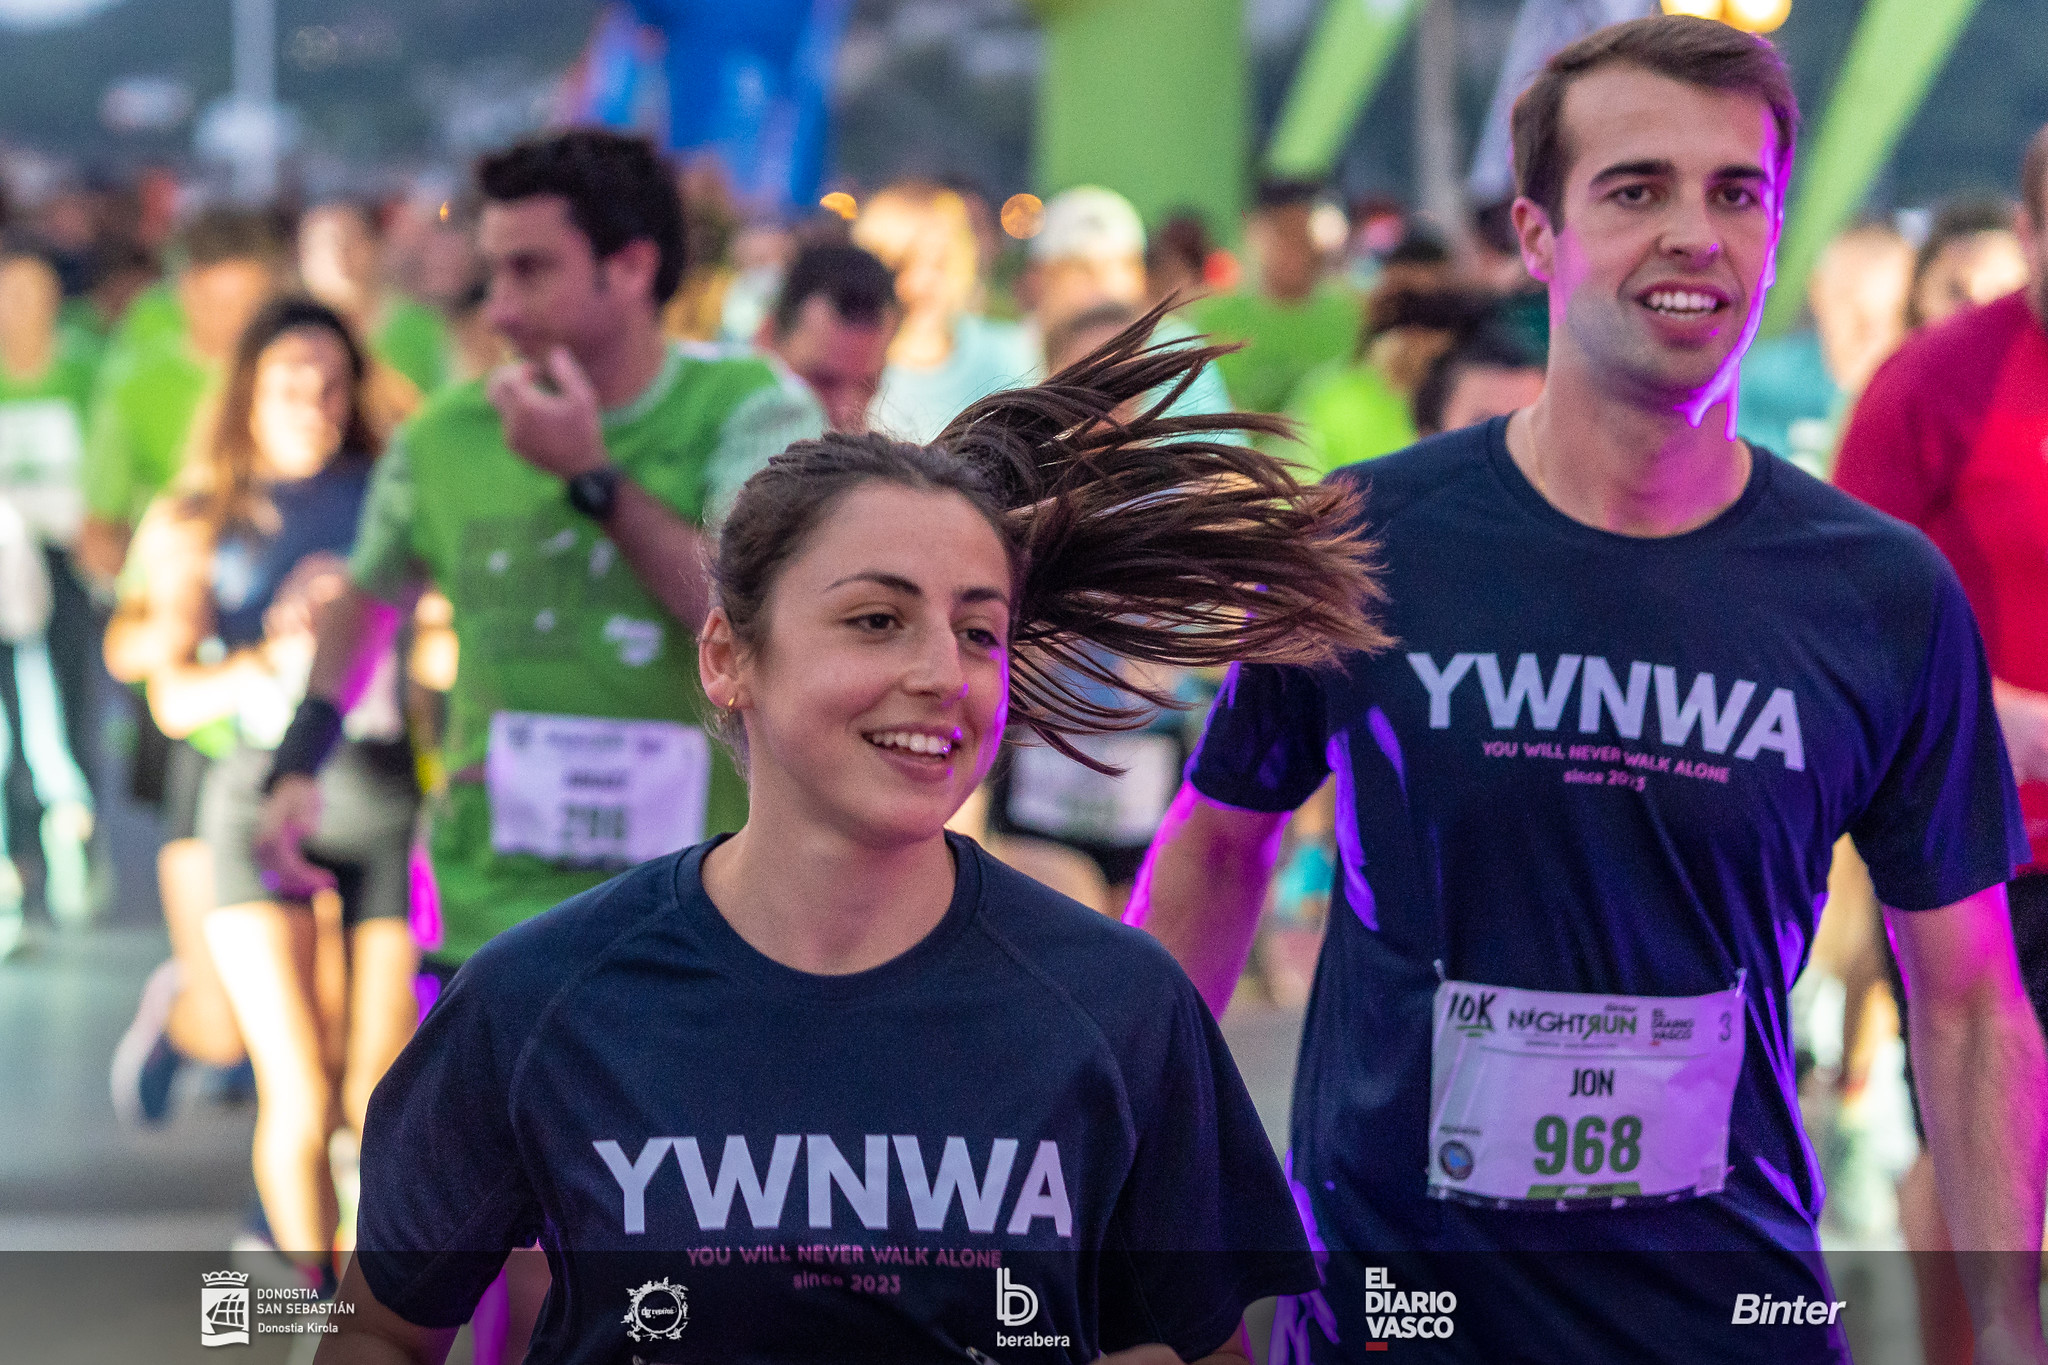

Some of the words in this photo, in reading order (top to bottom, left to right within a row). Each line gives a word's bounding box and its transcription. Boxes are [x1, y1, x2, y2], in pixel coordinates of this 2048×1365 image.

[1406, 652, 1806, 772] YWNWA
[1483, 741, 1518, 758] YOU
[1523, 742, 1565, 760] WILL
[1568, 744, 1622, 762] NEVER
[1623, 750, 1671, 772] WALK
[1673, 757, 1731, 783] ALONE
[1450, 992, 1496, 1029] 10K
[1719, 1010, 1733, 1042] 3
[1569, 1068, 1615, 1097] JON
[1534, 1115, 1643, 1176] 968
[593, 1134, 1073, 1238] YWNWA
[687, 1247, 731, 1267] YOU
[739, 1245, 791, 1264] WILL
[797, 1244, 865, 1265] NEVER
[871, 1246, 929, 1267] WALK
[936, 1248, 1001, 1269] ALONE
[793, 1271, 844, 1290] since
[851, 1274, 901, 1295] 2023
